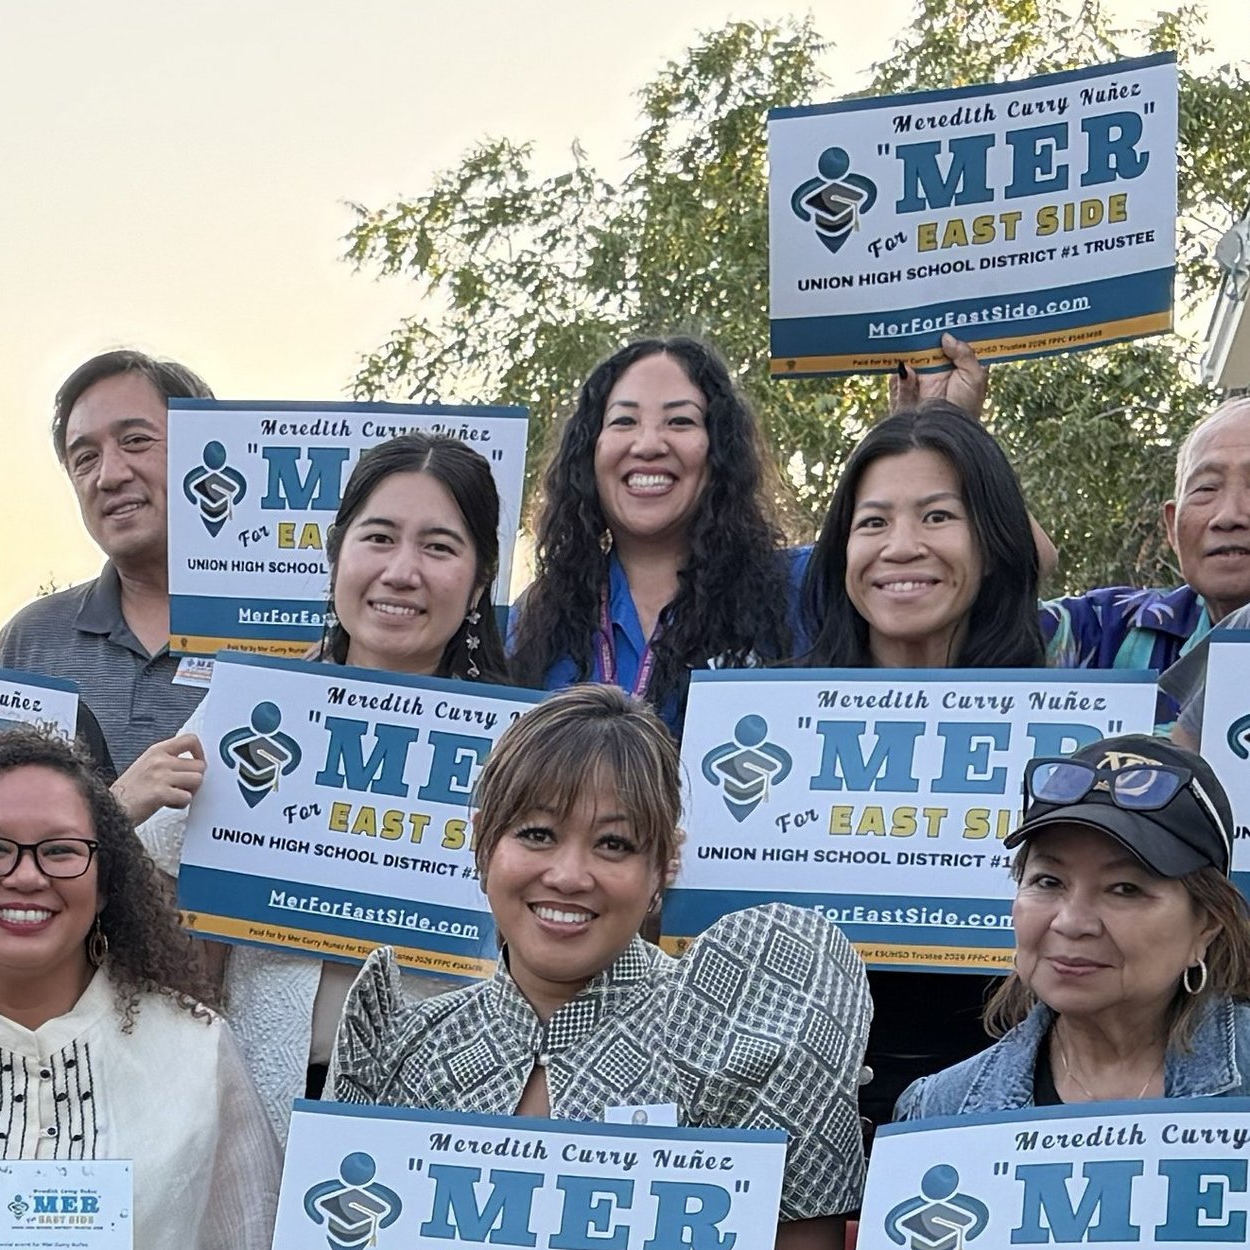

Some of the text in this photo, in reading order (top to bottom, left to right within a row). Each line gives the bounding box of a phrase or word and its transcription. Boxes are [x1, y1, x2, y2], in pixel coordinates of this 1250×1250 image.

[892, 83, 1142, 134] Meredith Curry Nuñez
[877, 102, 1156, 215] "MER"
[868, 193, 1128, 259] For EAST SIDE
[798, 230, 1155, 292] UNION HIGH SCHOOL DISTRICT #1 TRUSTEE
[868, 296, 1090, 338] MerForEastSide.com
[261, 419, 352, 437] Meredith
[238, 526, 270, 548] For
[188, 559, 328, 574] UNION HIGH SCHOOL
[328, 687, 424, 715] Meredith
[435, 701, 498, 729] Curry
[817, 690, 1107, 714] Meredith Curry Nuñez
[308, 710, 493, 807] "ME
[283, 802, 431, 844] For EAST
[776, 806, 949, 838] For EAST
[212, 827, 479, 881] UNION HIGH SCHOOL DISTRICT #1
[697, 847, 1012, 868] UNION HIGH SCHOOL DISTRICT #1
[268, 889, 479, 938] MerForEastSide.com
[811, 903, 1015, 927] ForEastSide.com
[429, 1133, 734, 1171] Meredith Curry Nuñez
[1015, 1124, 1250, 1151] Meredith Curry
[993, 1160, 1250, 1243] "ME
